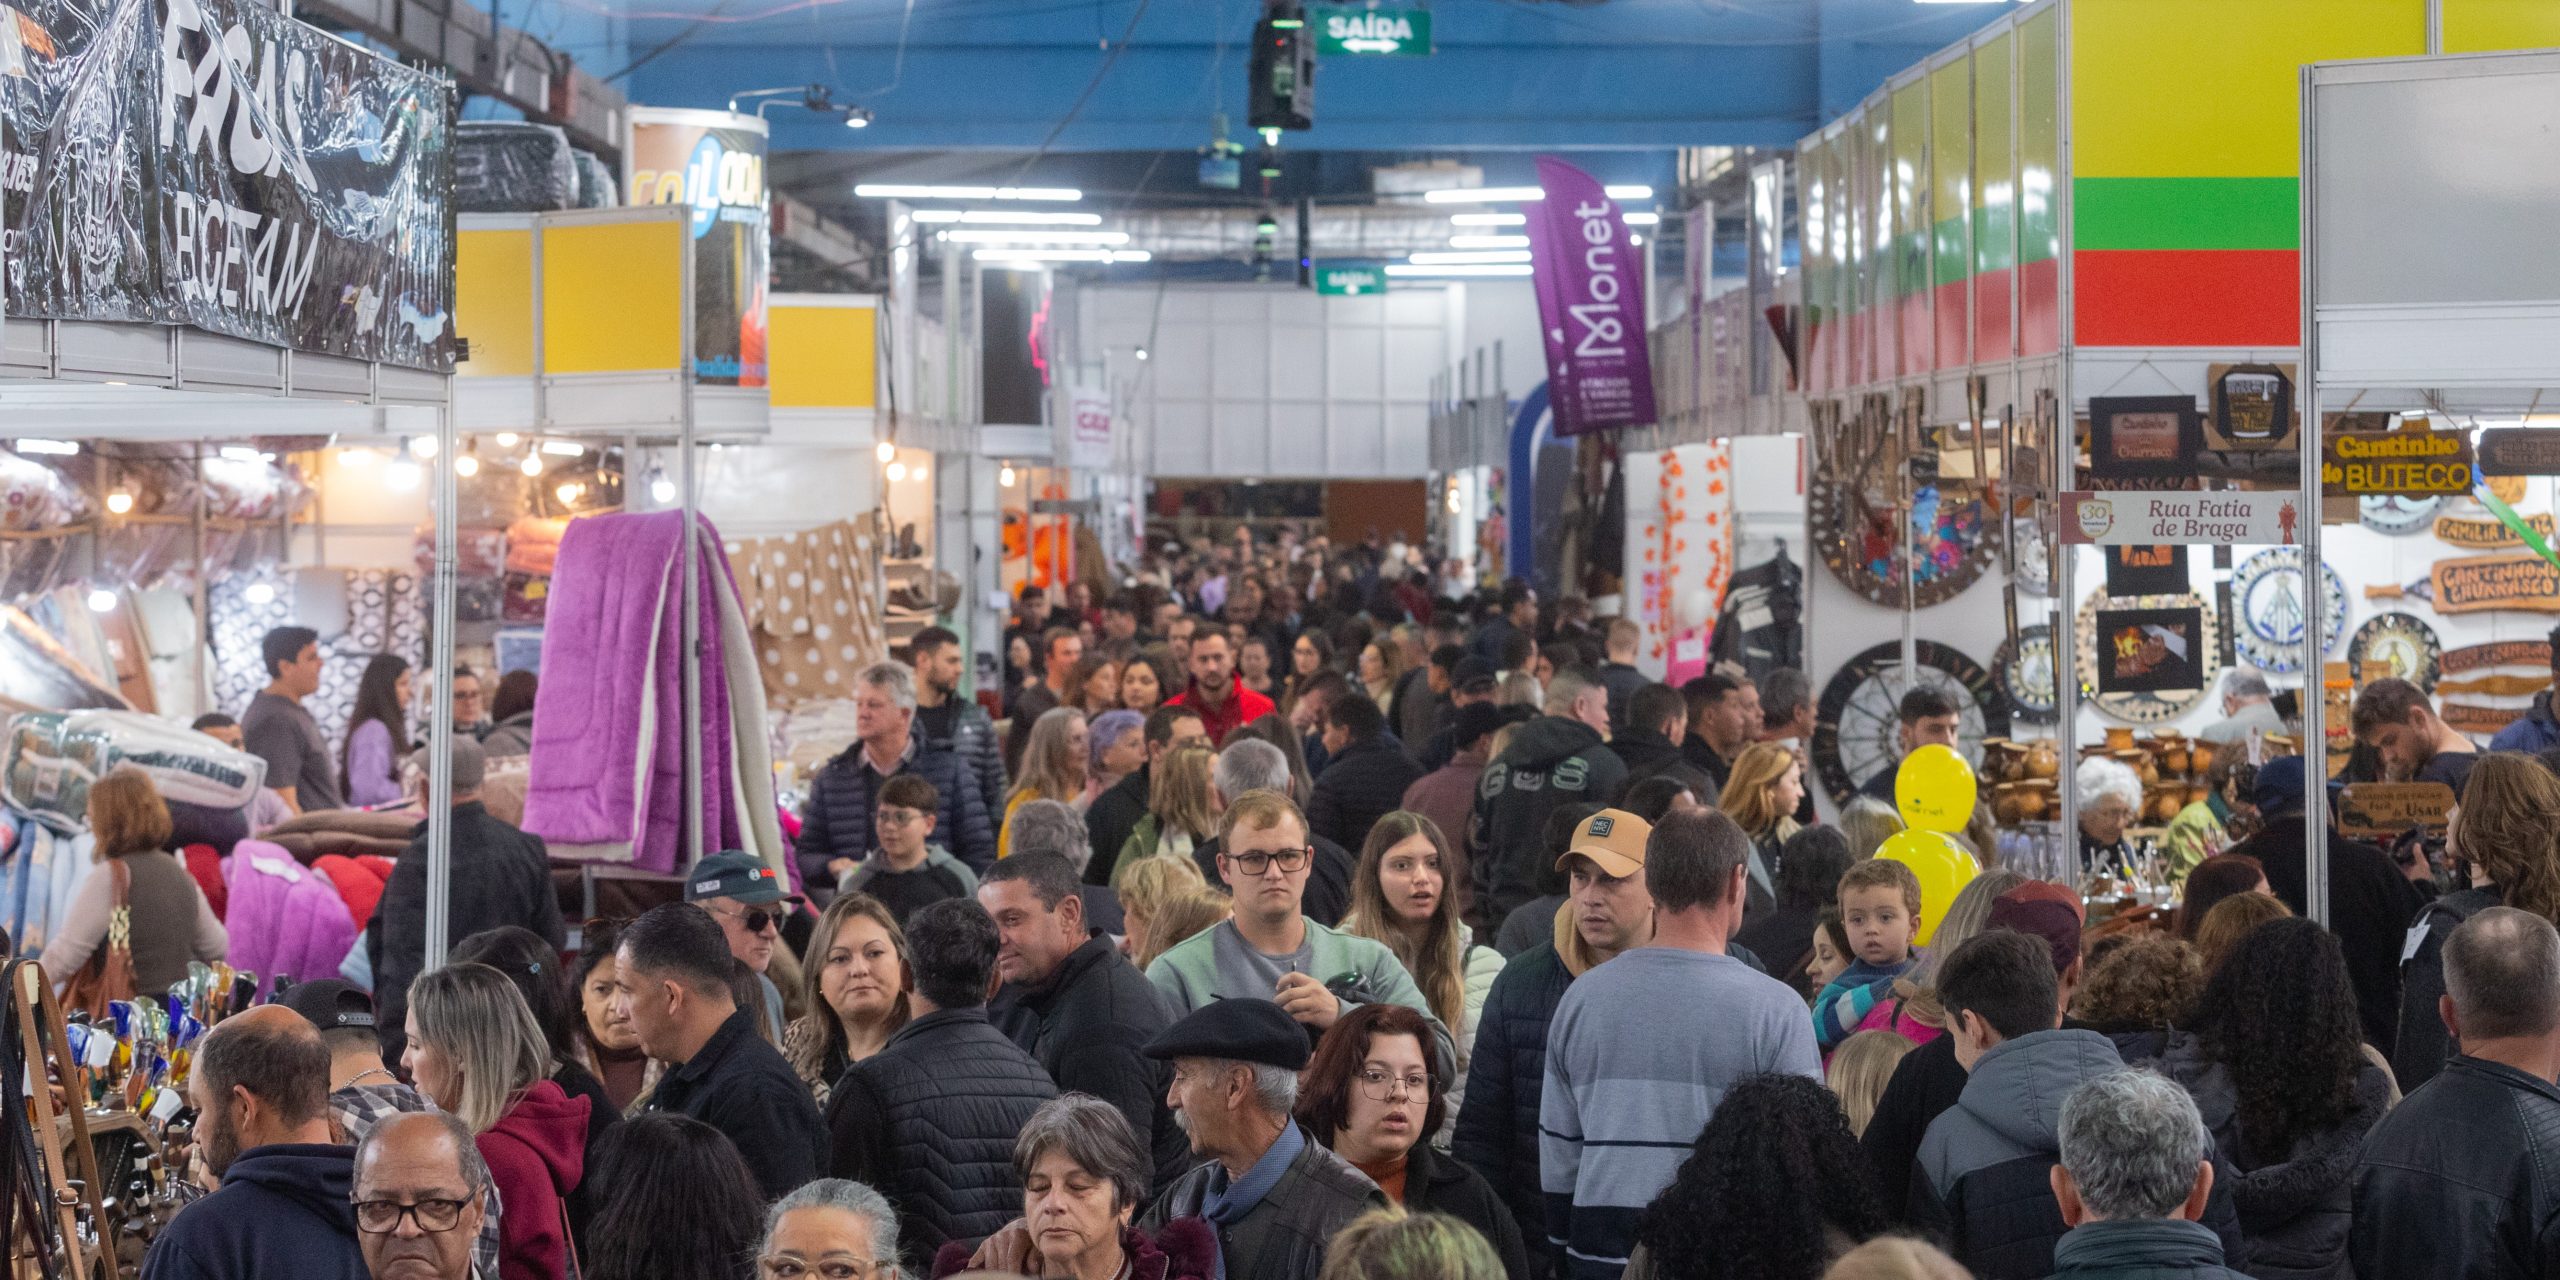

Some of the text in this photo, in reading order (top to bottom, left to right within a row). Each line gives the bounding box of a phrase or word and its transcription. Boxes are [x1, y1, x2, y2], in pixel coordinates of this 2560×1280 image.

[1327, 12, 1413, 40] SAÍDA
[1569, 200, 1626, 357] Monet
[2336, 433, 2459, 457] Cantinho
[2346, 463, 2471, 490] BUTECO
[2149, 499, 2251, 517] Rua Fatia
[2152, 519, 2248, 542] de Braga
